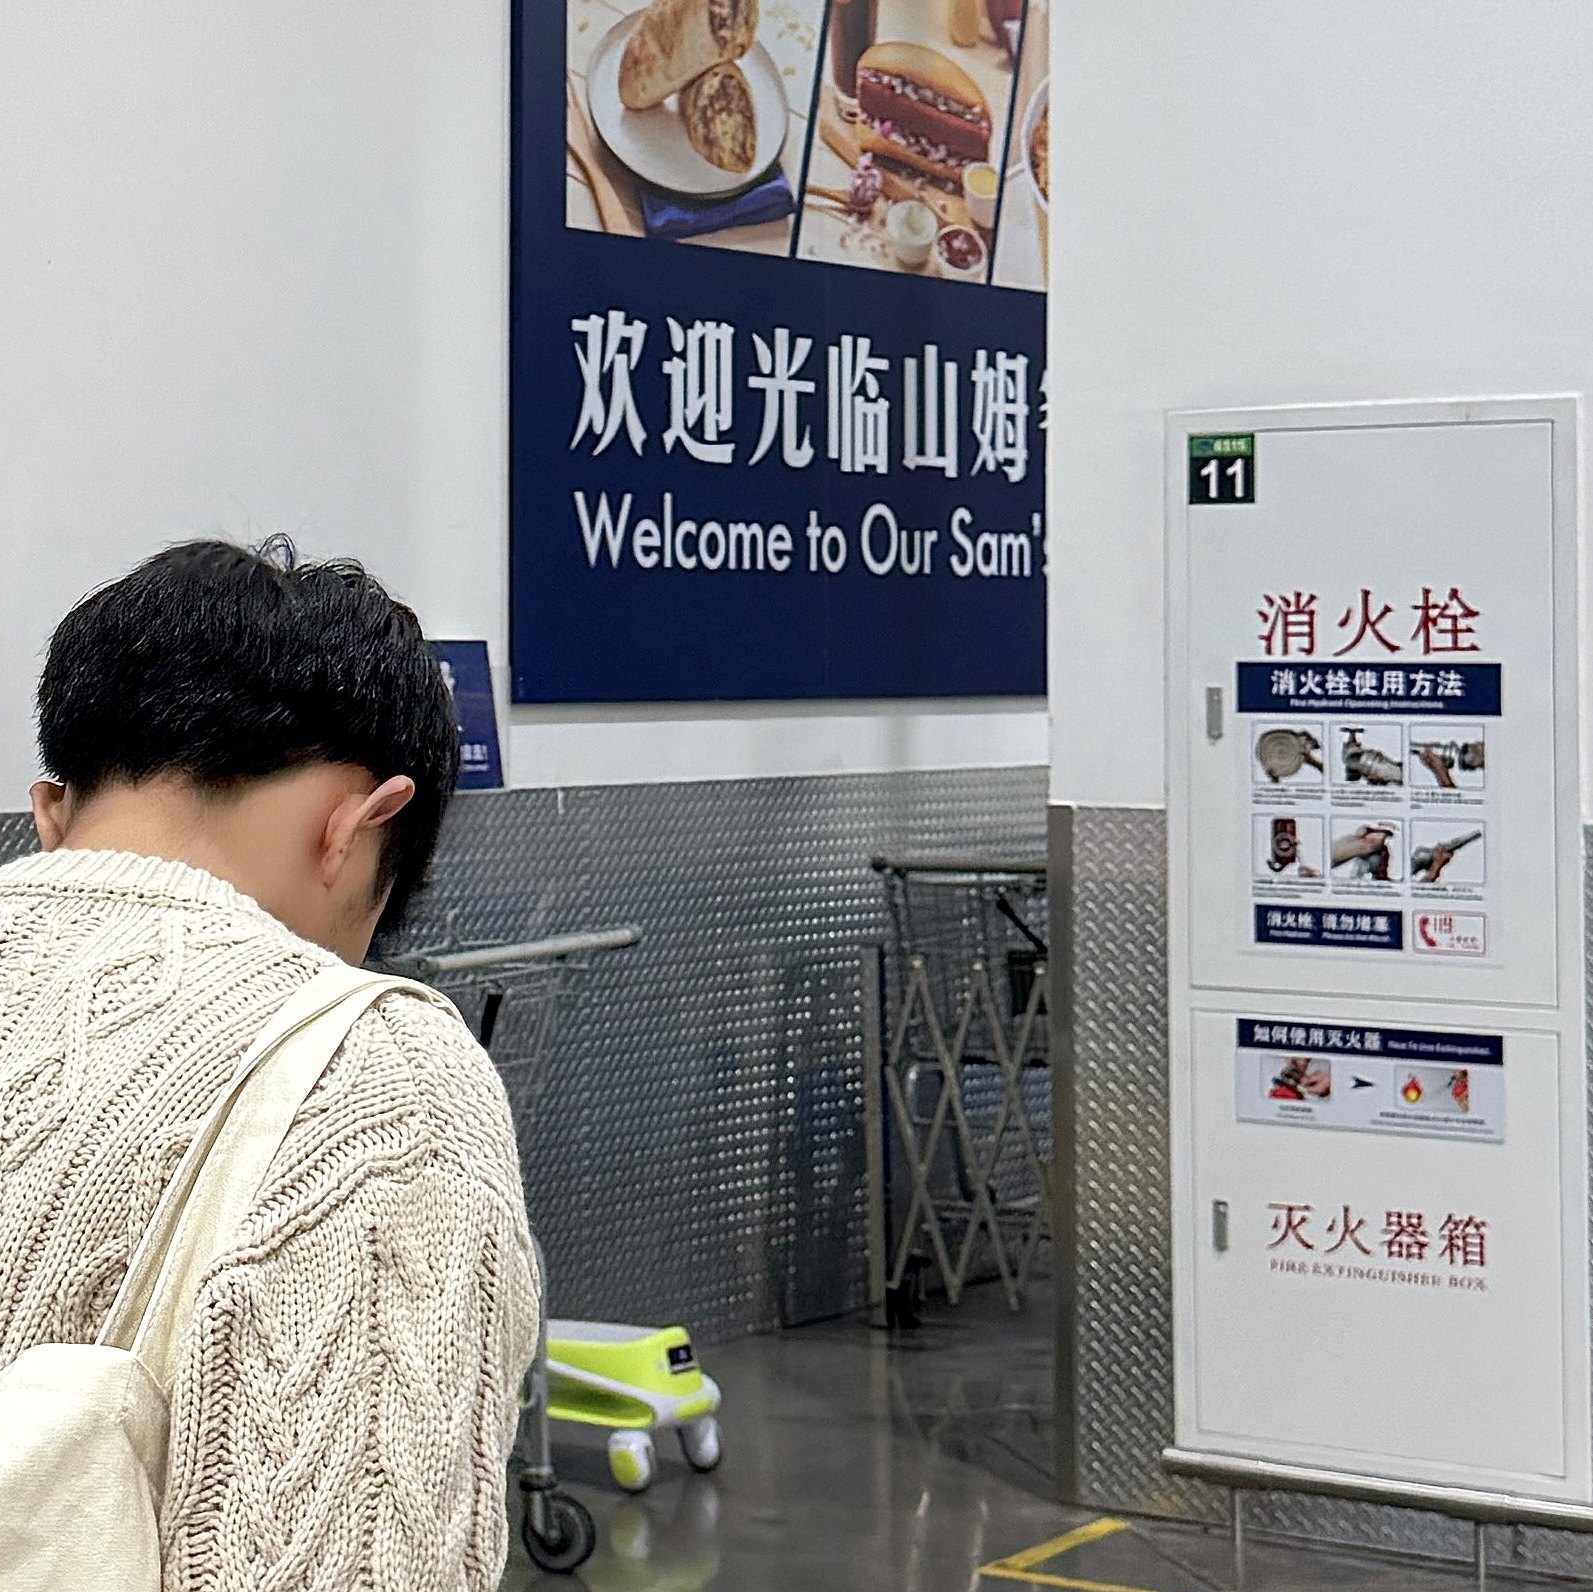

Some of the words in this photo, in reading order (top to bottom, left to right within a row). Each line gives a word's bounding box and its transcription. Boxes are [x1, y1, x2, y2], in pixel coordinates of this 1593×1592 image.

[570, 310, 1047, 483] 欢迎光临山姆
[1200, 459, 1244, 498] 11
[573, 491, 792, 570] Welcome
[806, 510, 846, 574] to
[861, 503, 937, 575] Our
[950, 507, 1046, 577] Sam'
[1256, 587, 1481, 657] 消火栓
[1271, 669, 1465, 697] 消火栓使用方法
[1254, 1024, 1383, 1051] 如何使用灭火器
[1266, 1203, 1488, 1267] 灭火器箱
